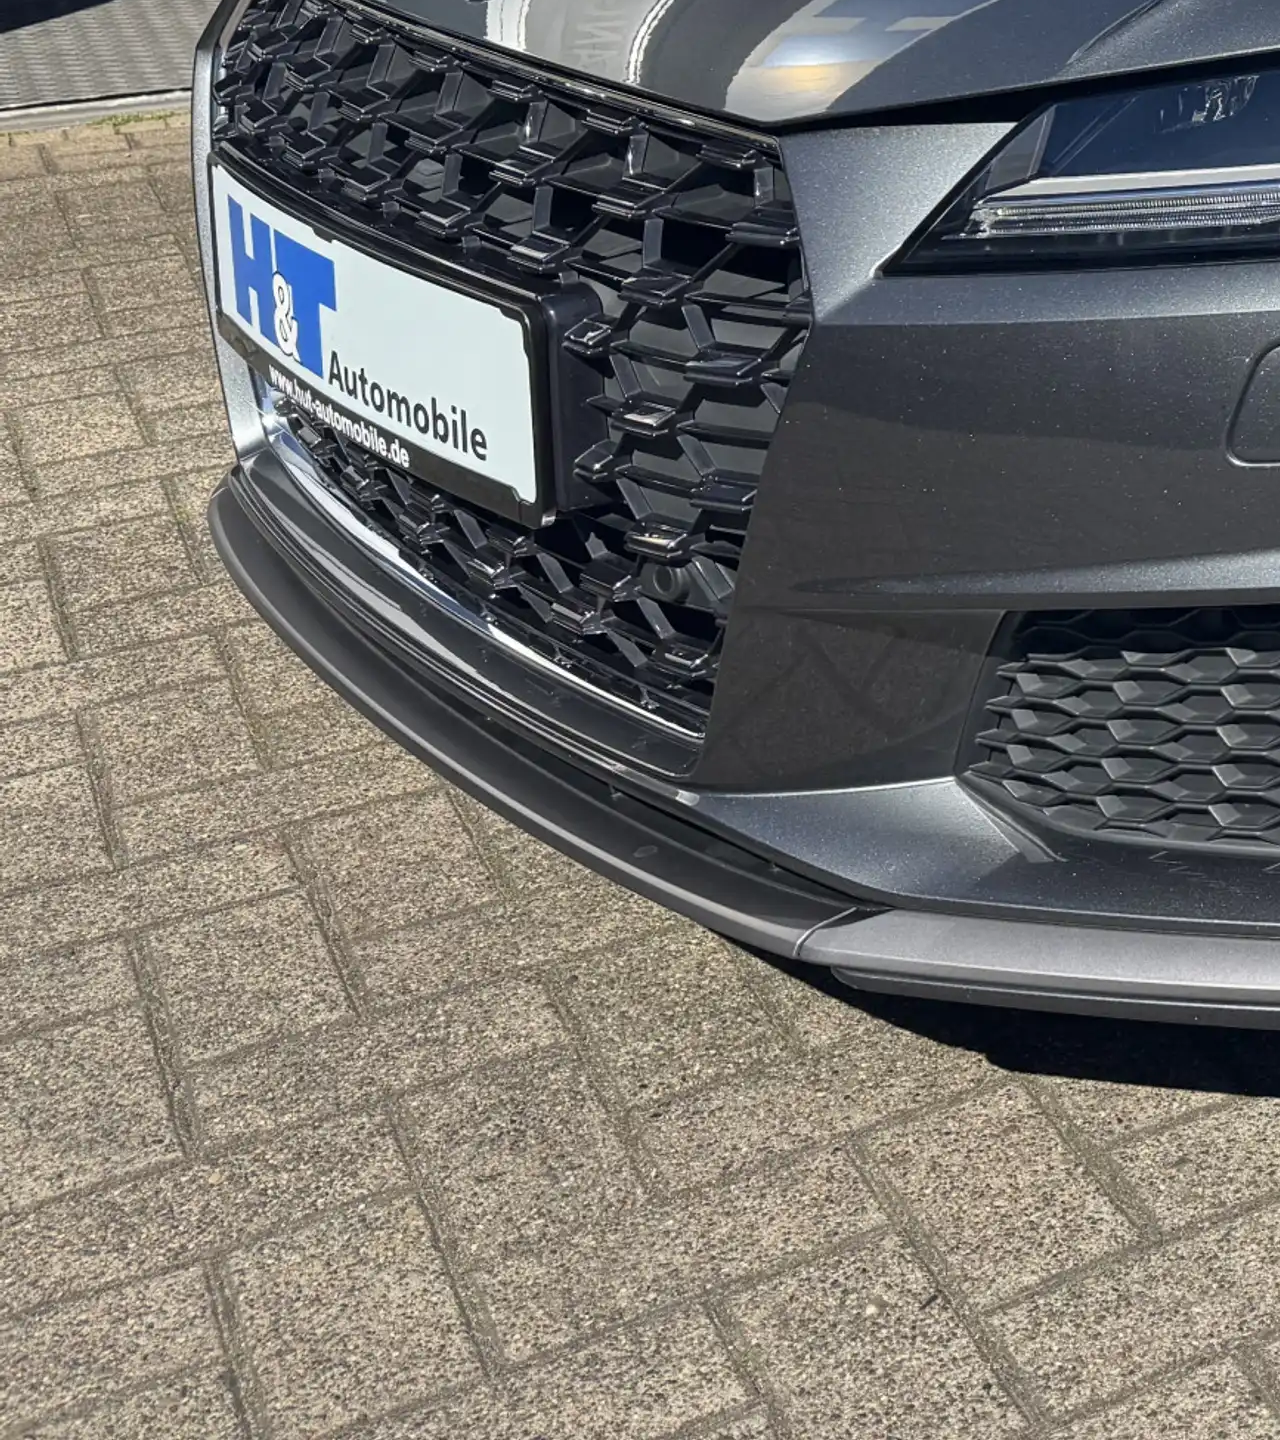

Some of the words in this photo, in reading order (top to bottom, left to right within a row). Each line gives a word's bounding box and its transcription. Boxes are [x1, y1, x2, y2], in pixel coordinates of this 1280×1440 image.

[227, 194, 337, 379] H&T
[267, 364, 411, 469] www.hut-automobile.de
[327, 350, 488, 462] Automobile
